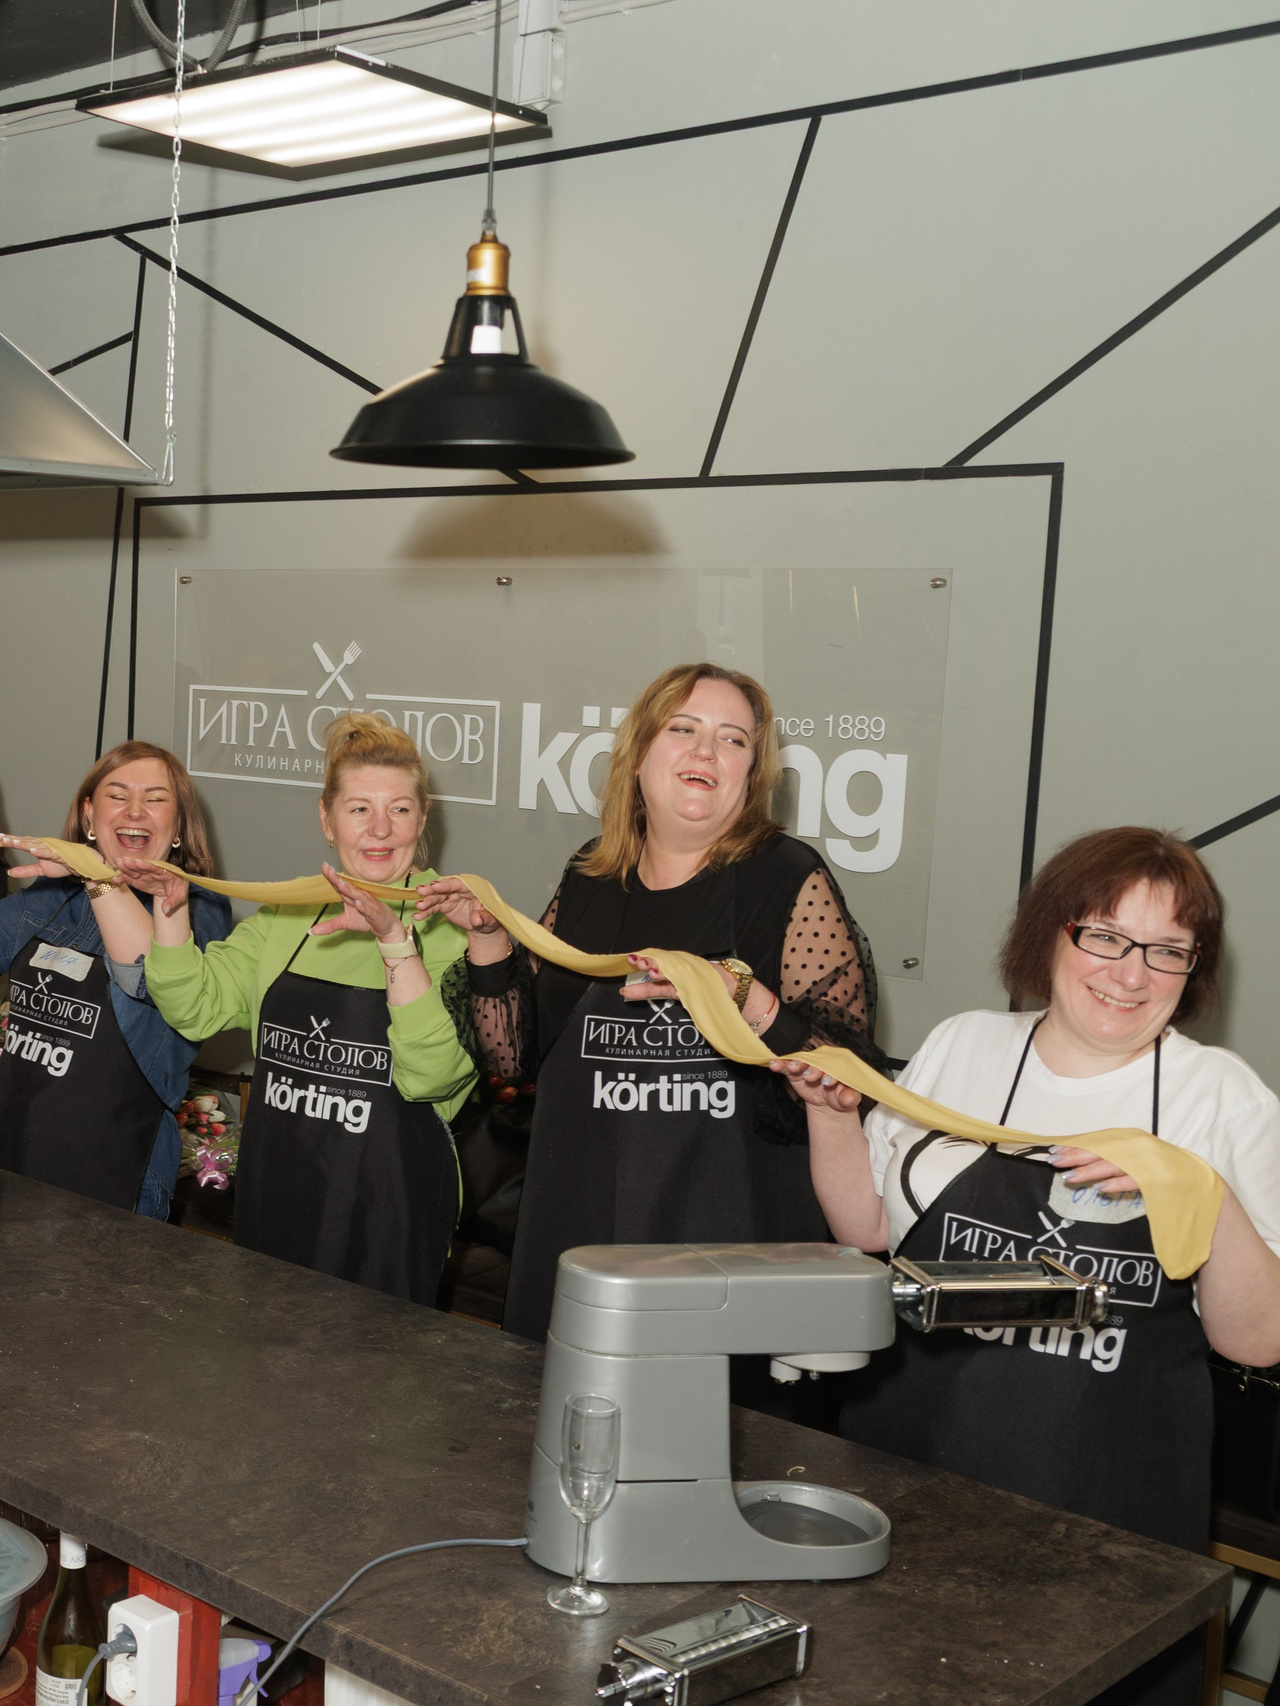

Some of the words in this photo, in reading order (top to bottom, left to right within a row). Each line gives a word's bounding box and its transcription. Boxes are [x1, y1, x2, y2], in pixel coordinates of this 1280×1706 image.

[198, 698, 298, 750] ИГРА
[775, 717, 815, 738] nce
[824, 714, 886, 742] 1889
[234, 752, 325, 774] КУЛИНАРН
[518, 702, 909, 874] köng
[30, 992, 94, 1025] СТОЛОВ
[263, 1027, 300, 1056] ИГРА
[303, 1039, 388, 1071] СТОЛОВ
[588, 1021, 638, 1046] ИГРА
[643, 1024, 706, 1047] СТО
[275, 1051, 320, 1069] КУЛИНАРНАЯ
[324, 1064, 360, 1076] СТУДИЯ
[605, 1047, 670, 1057] КУЛИНАРНАЯ
[676, 1049, 711, 1057] СТУДИ
[682, 1072, 705, 1080] since
[707, 1070, 729, 1080] 1889
[264, 1071, 372, 1134] körting
[326, 1085, 346, 1096] since
[348, 1089, 367, 1099] 1889
[592, 1070, 736, 1119] körting
[950, 1221, 1018, 1263] ИГРА
